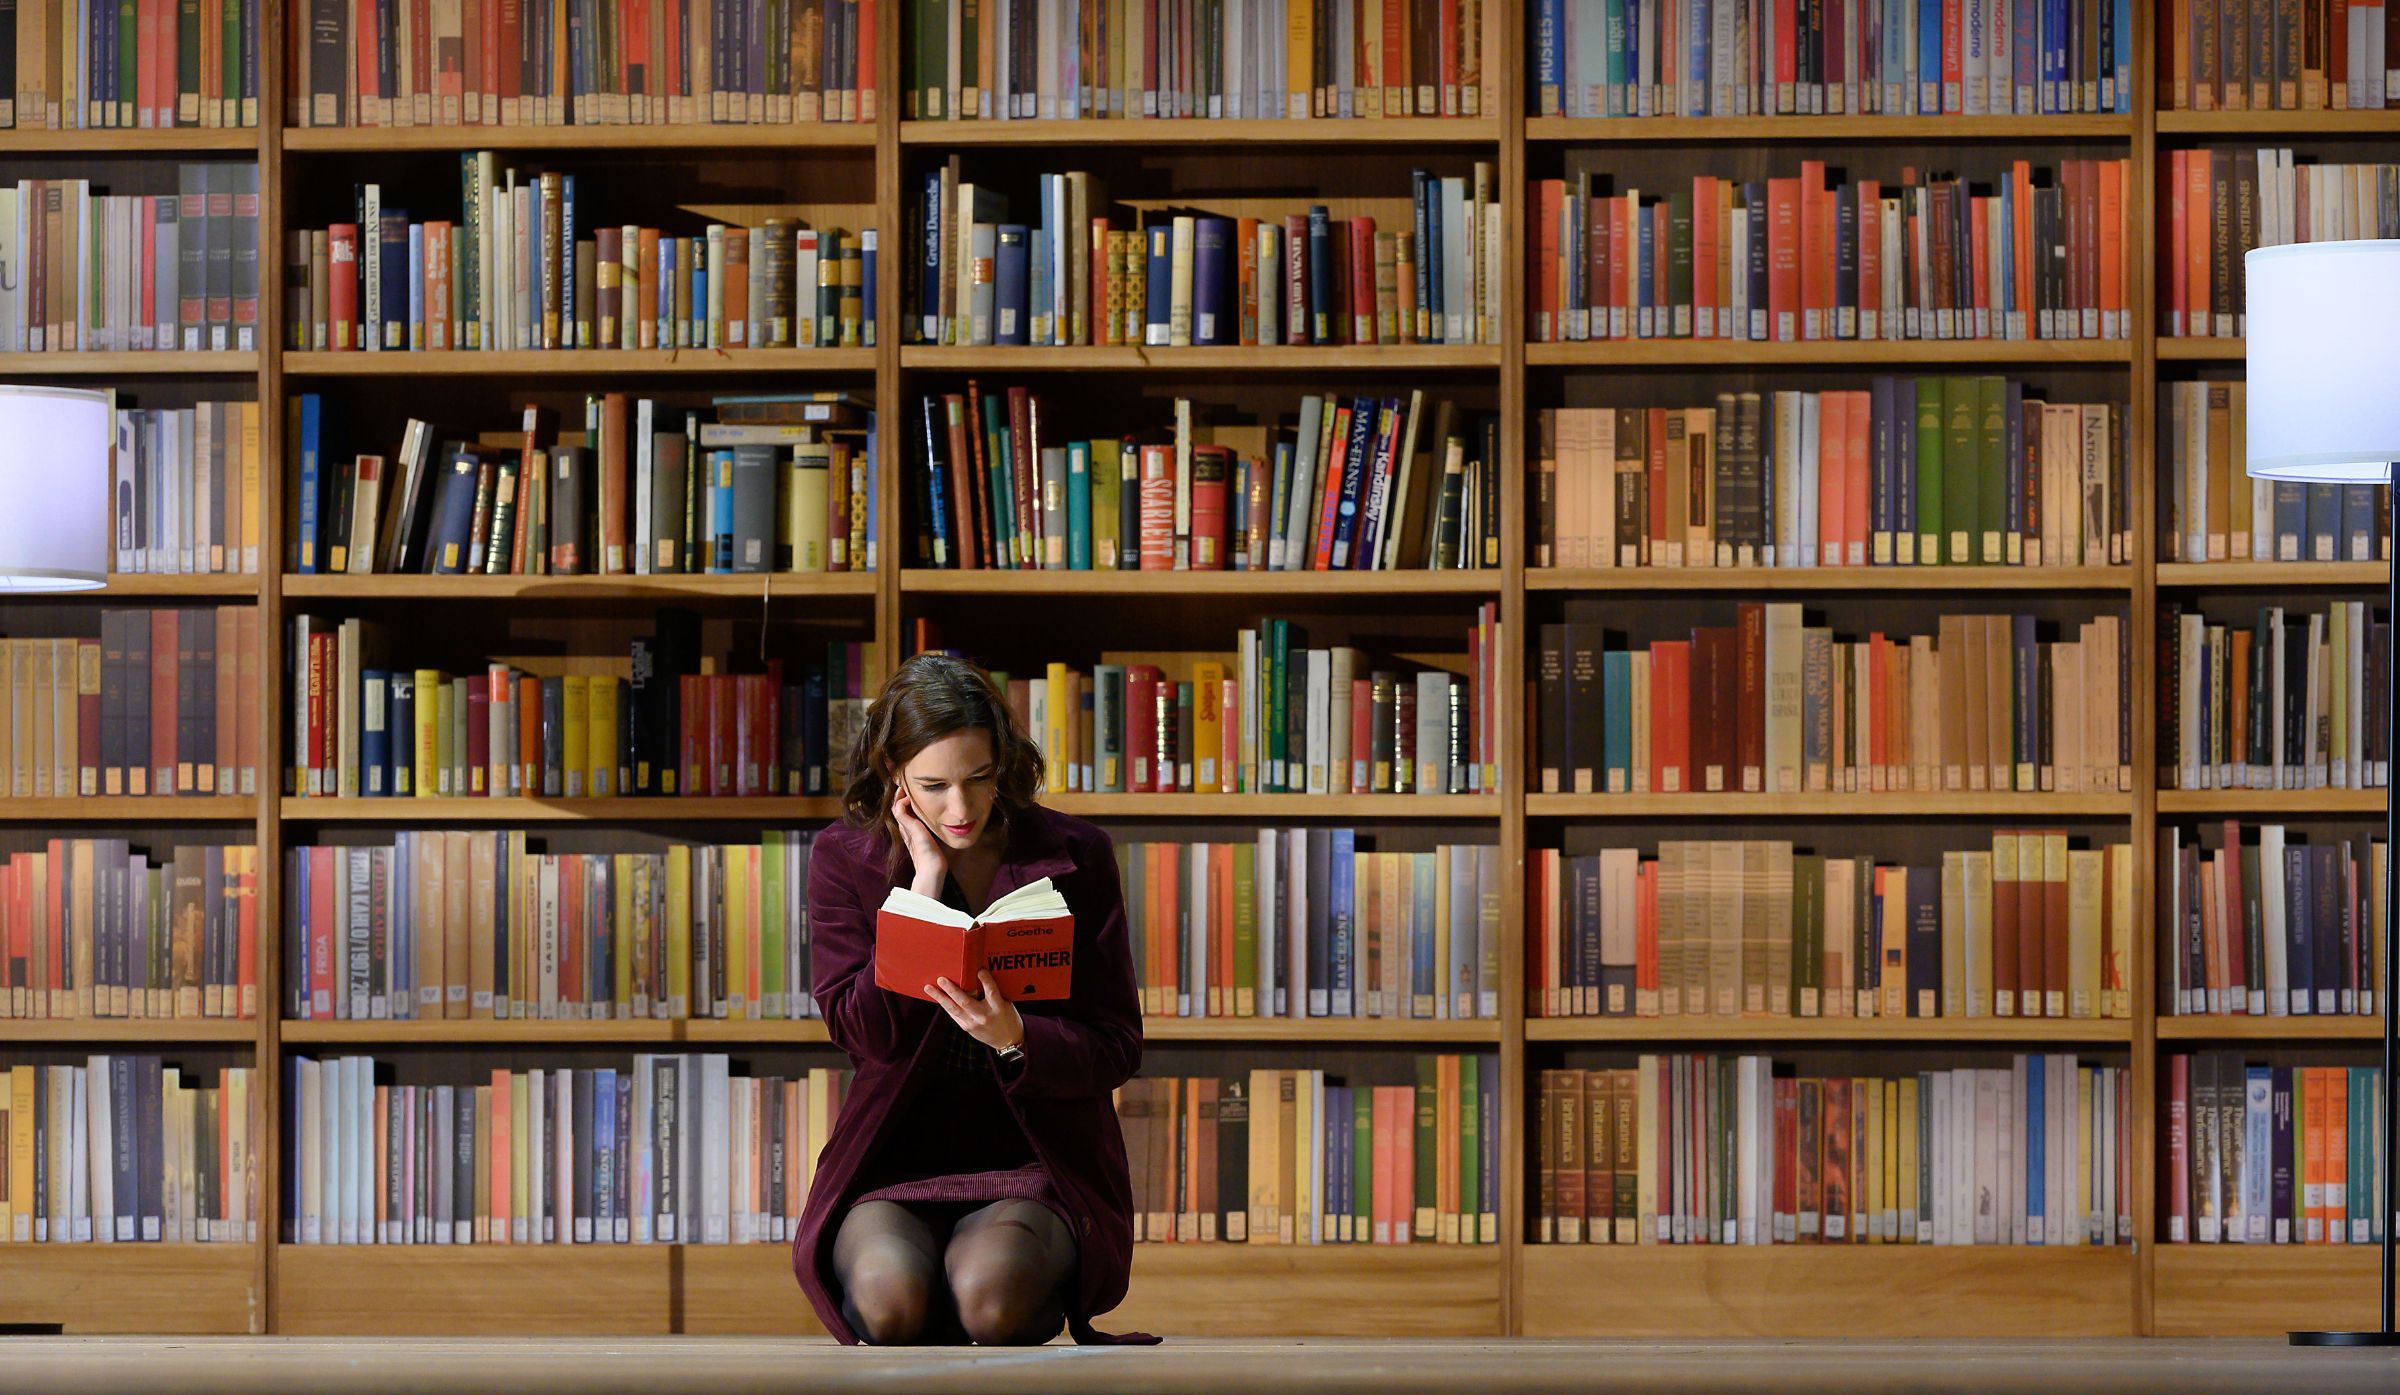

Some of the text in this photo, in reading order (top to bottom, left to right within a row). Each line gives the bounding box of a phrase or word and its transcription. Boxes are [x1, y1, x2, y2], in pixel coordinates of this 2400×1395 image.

[1537, 17, 1554, 83] MUSÉES
[1970, 0, 1983, 58] moderne
[1994, 0, 2008, 57] moderne
[924, 179, 940, 267] Große Deutsche
[1343, 410, 1369, 499] MAX ERNST
[2086, 416, 2104, 481] NATIONS
[1141, 479, 1174, 558] SCARLETT
[1365, 451, 1390, 521] Kandinsky
[350, 851, 370, 892] FRIDA
[315, 935, 329, 976] FRIDA
[545, 900, 553, 975] GAUGUIN
[987, 951, 1071, 972] WERTHER
[1006, 927, 1054, 938] Goethe
[1336, 911, 1349, 990] BARCELONE
[1562, 1098, 1575, 1163] Britannica
[1593, 1099, 1606, 1163] Britannica
[1619, 1098, 1632, 1163] Britannica
[2222, 1105, 2234, 1177] Performance
[599, 1147, 610, 1218] BARCELONE
